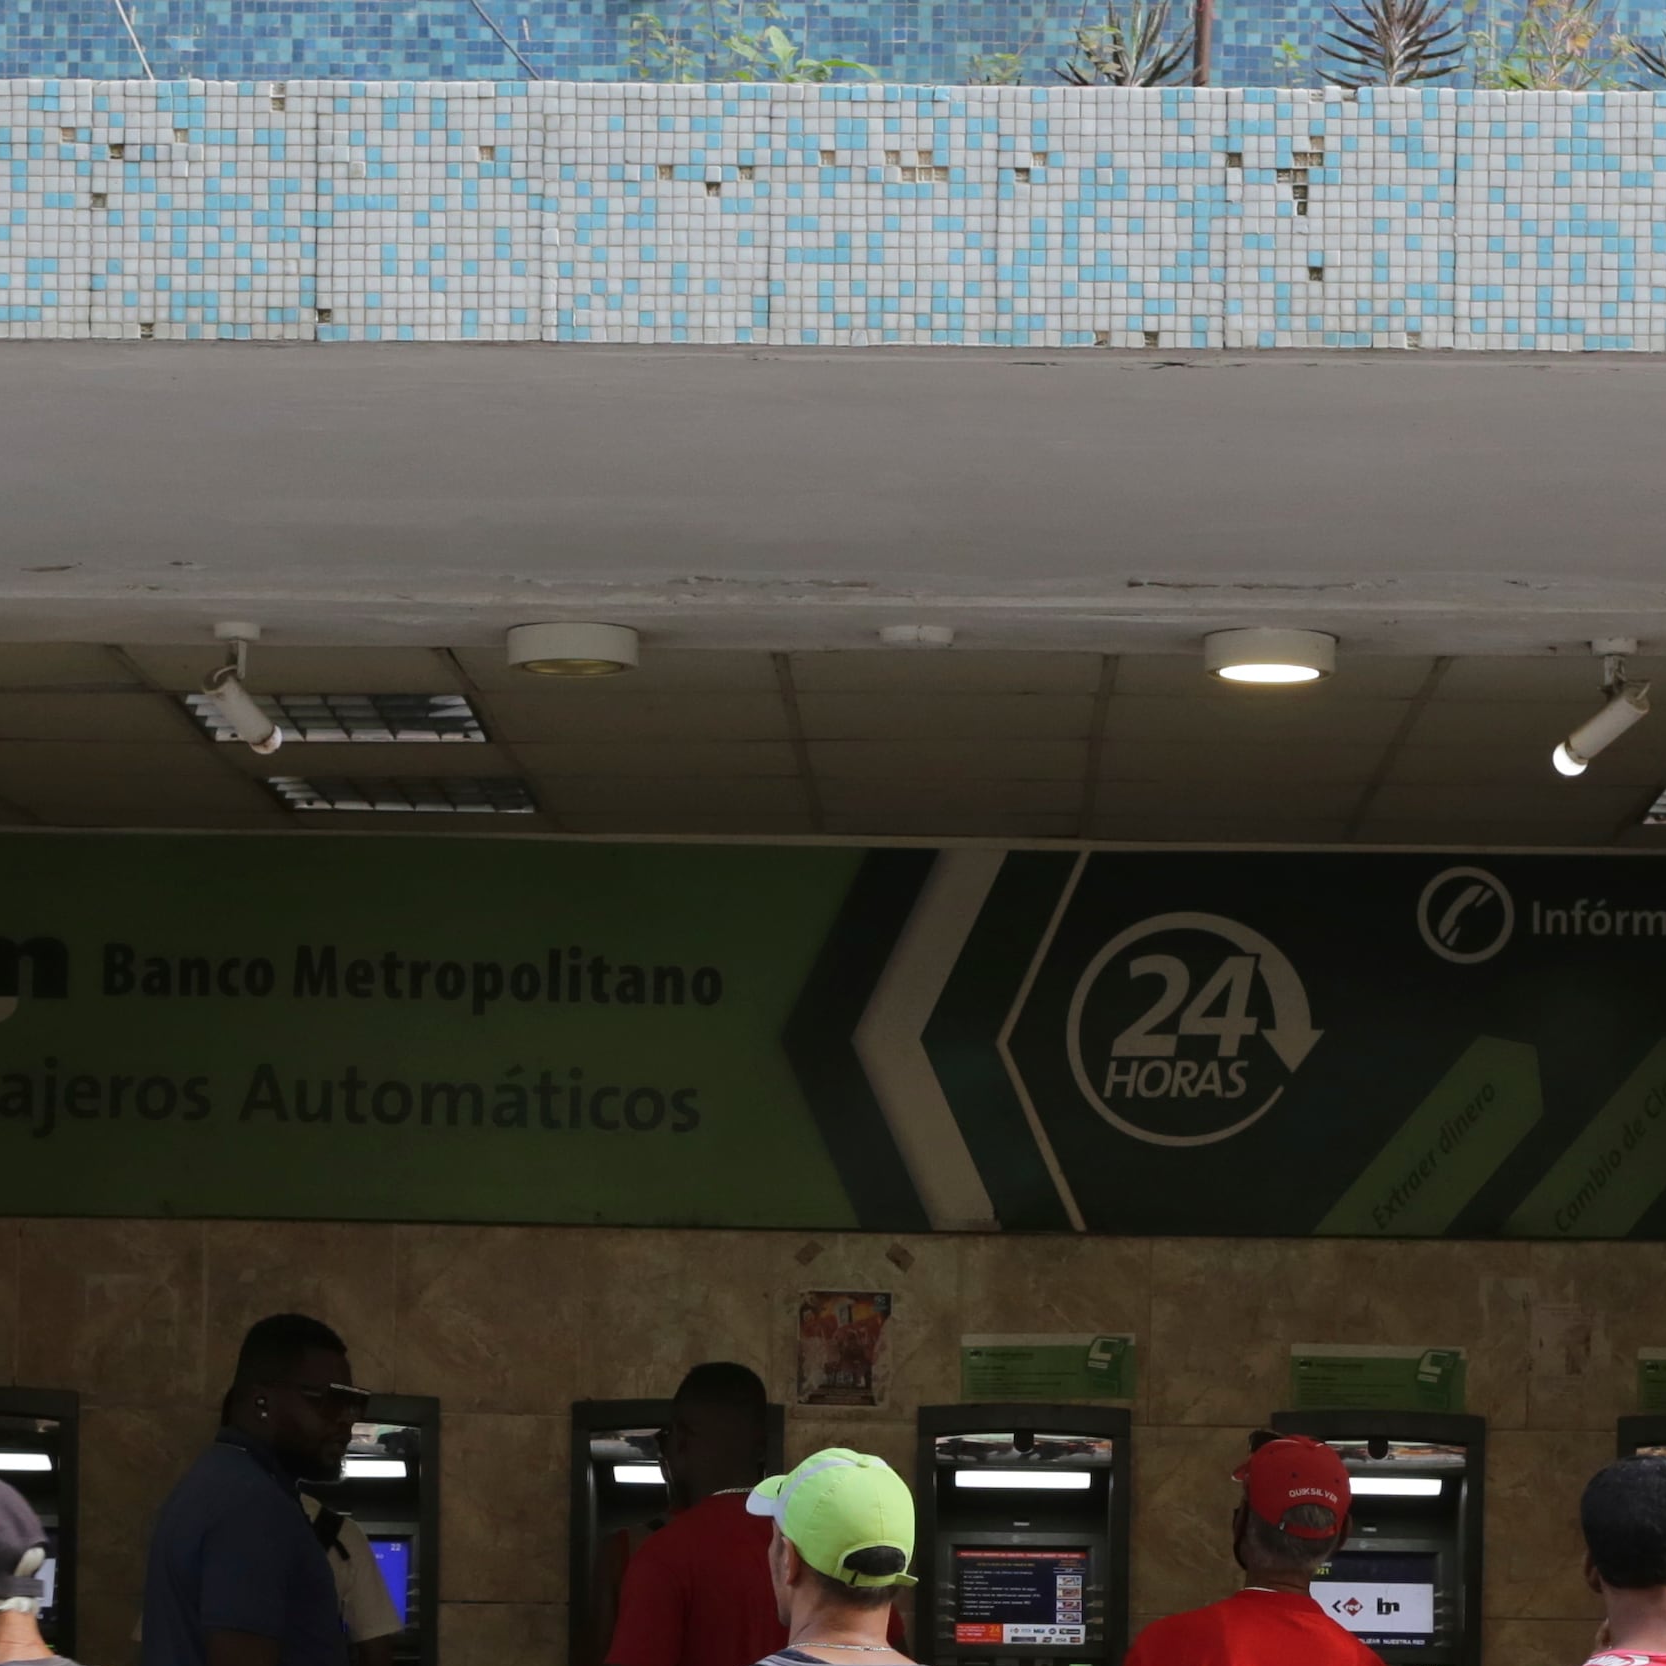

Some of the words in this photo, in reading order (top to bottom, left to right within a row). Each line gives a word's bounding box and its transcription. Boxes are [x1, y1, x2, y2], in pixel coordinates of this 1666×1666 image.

[102, 942, 276, 998] Banco
[292, 945, 724, 1016] Metropolitano
[1110, 953, 1259, 1057] 24
[237, 1063, 701, 1133] Automáticos
[1103, 1060, 1250, 1099] HORAS
[1371, 1147, 1439, 1231] Extraer
[1438, 1081, 1497, 1163] dinero
[1554, 1148, 1623, 1235] Cambio
[1621, 1116, 1649, 1152] de
